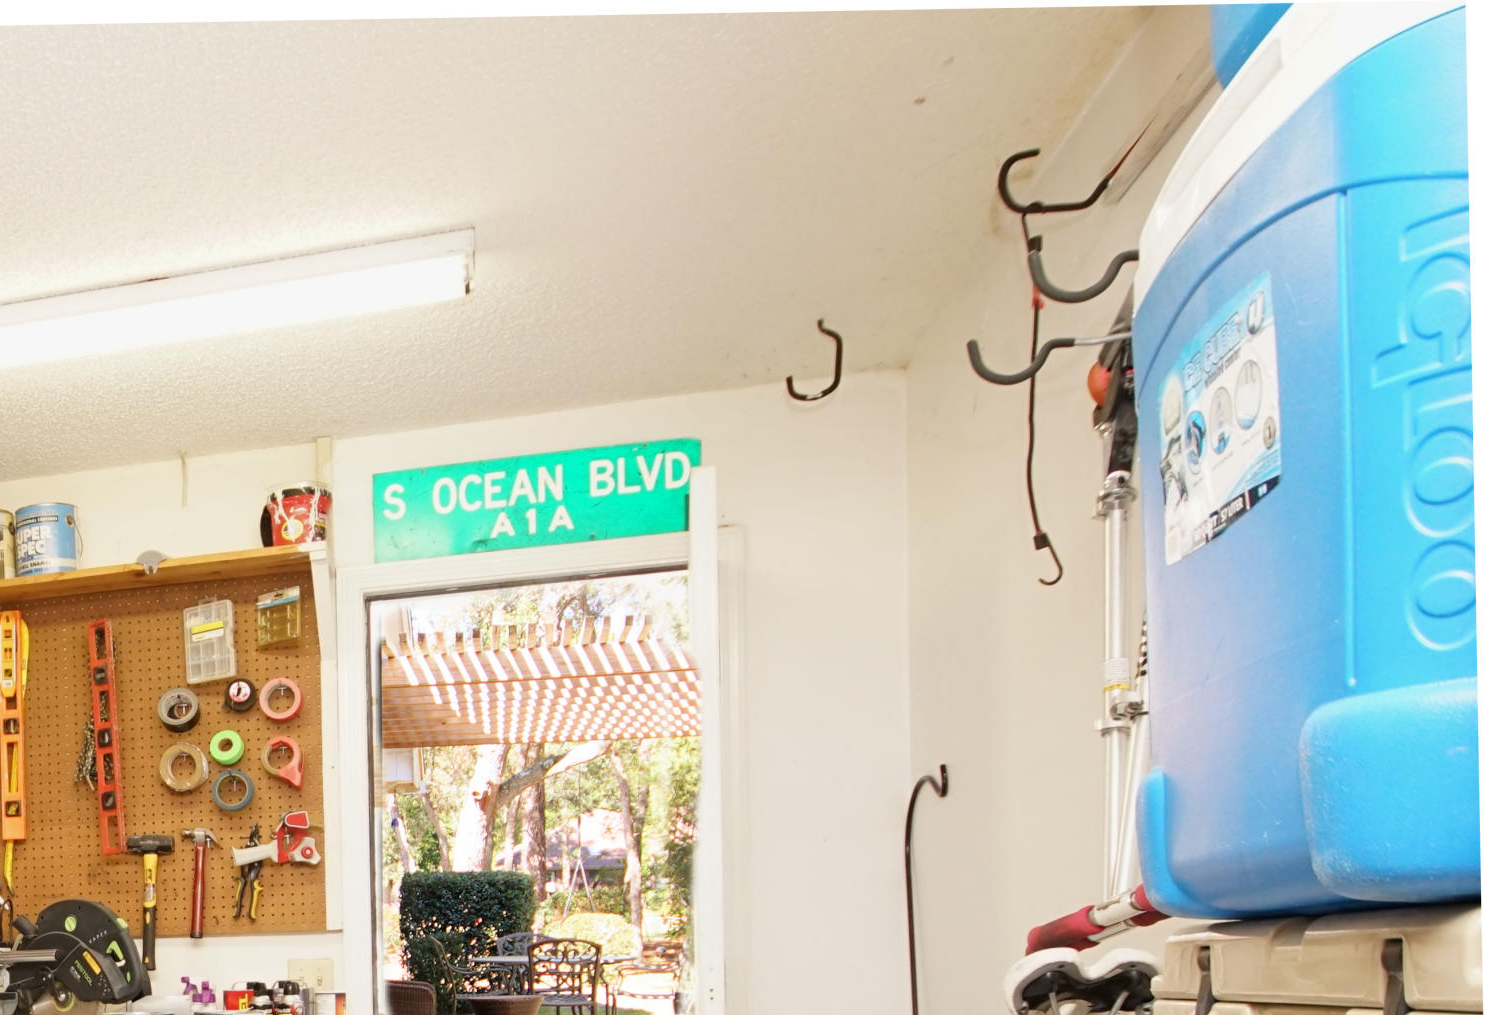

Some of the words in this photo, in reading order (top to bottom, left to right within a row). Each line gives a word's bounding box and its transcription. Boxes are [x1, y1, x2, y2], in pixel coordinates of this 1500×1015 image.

[384, 484, 406, 520] S
[432, 465, 563, 515] OCEAN
[589, 452, 691, 498] BLVD
[17, 524, 52, 545] UPER
[490, 506, 574, 537] A1A
